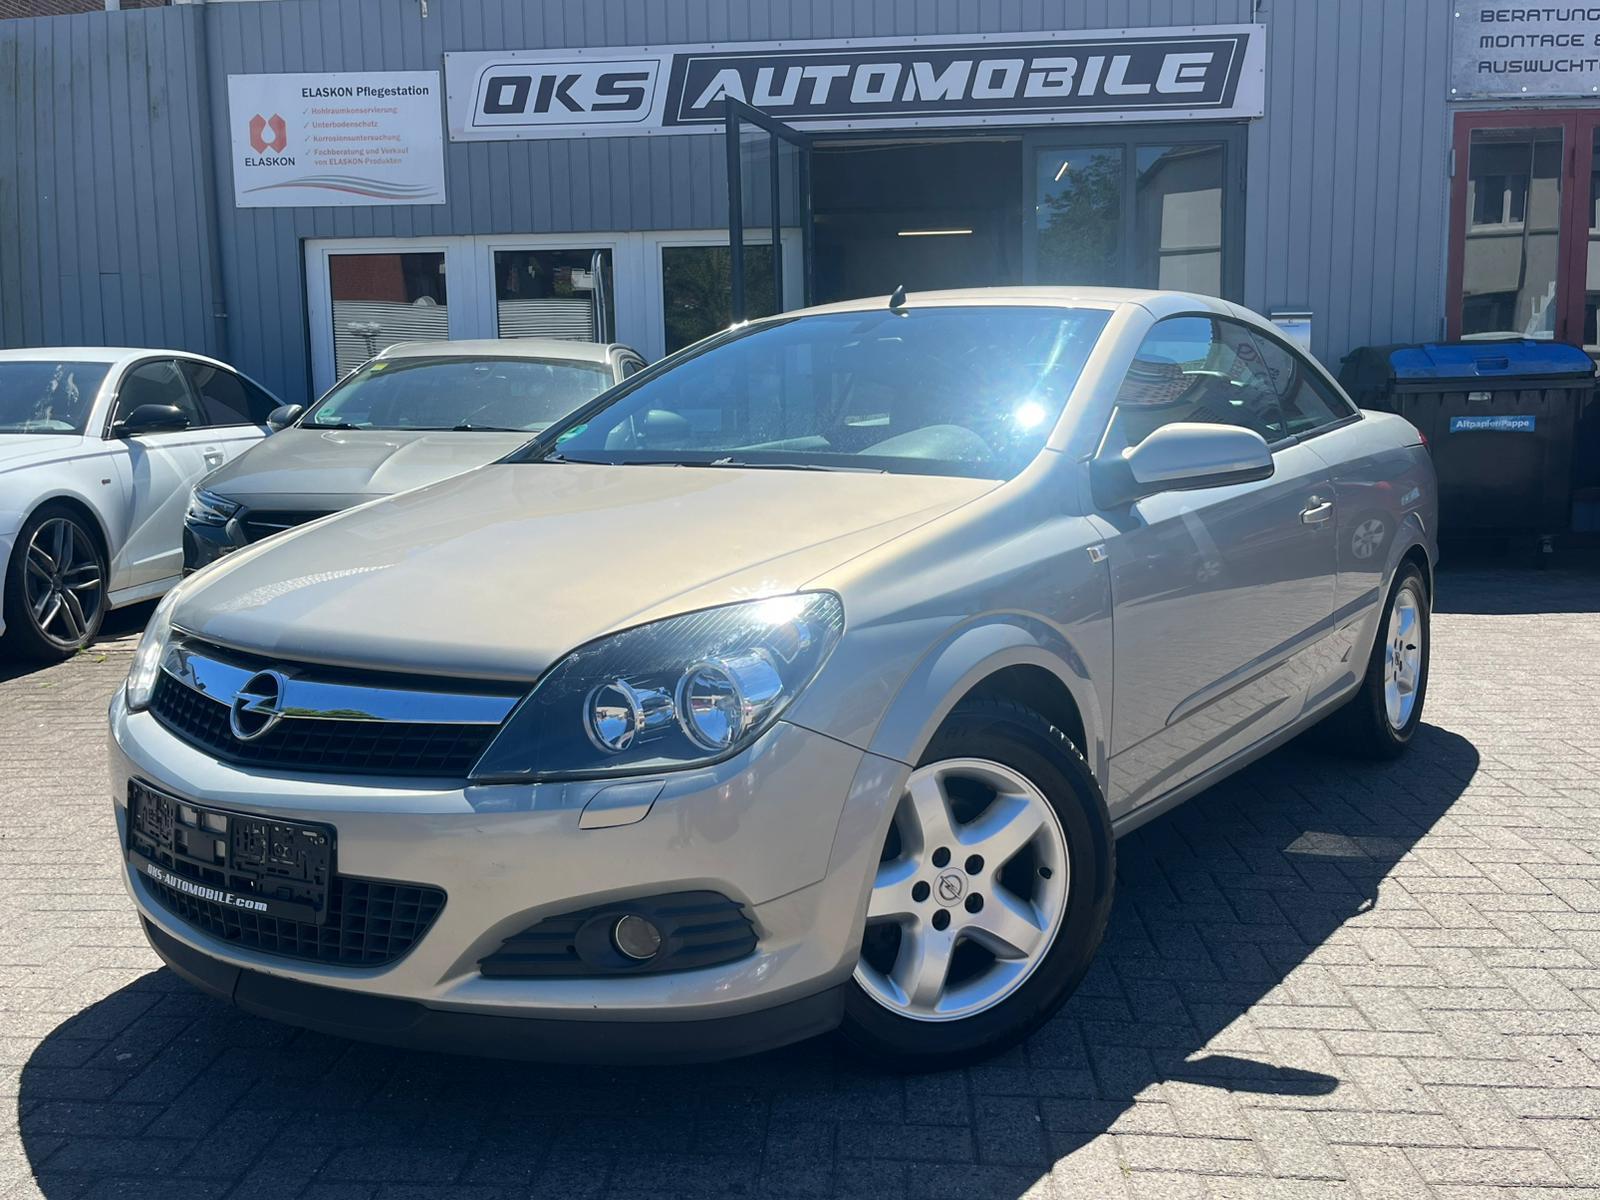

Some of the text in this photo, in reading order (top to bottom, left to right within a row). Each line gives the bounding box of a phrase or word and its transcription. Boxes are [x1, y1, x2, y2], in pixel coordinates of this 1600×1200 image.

[1479, 34, 1585, 48] MONTAGE
[1478, 59, 1600, 73] AUSWUCHT
[483, 52, 1215, 115] OKS AUTOMOBILE
[302, 85, 429, 98] ELASKON Pflegestation
[311, 106, 398, 115] Hohlraumkonservierung
[312, 120, 378, 129] Unterbodenschutz
[314, 148, 365, 156] Fachberatung
[381, 147, 409, 155] Verkauf
[245, 157, 296, 167] ELASKON
[329, 158, 364, 166] ELASKON
[147, 863, 268, 912] OKS-AUTOMOBILE.com
